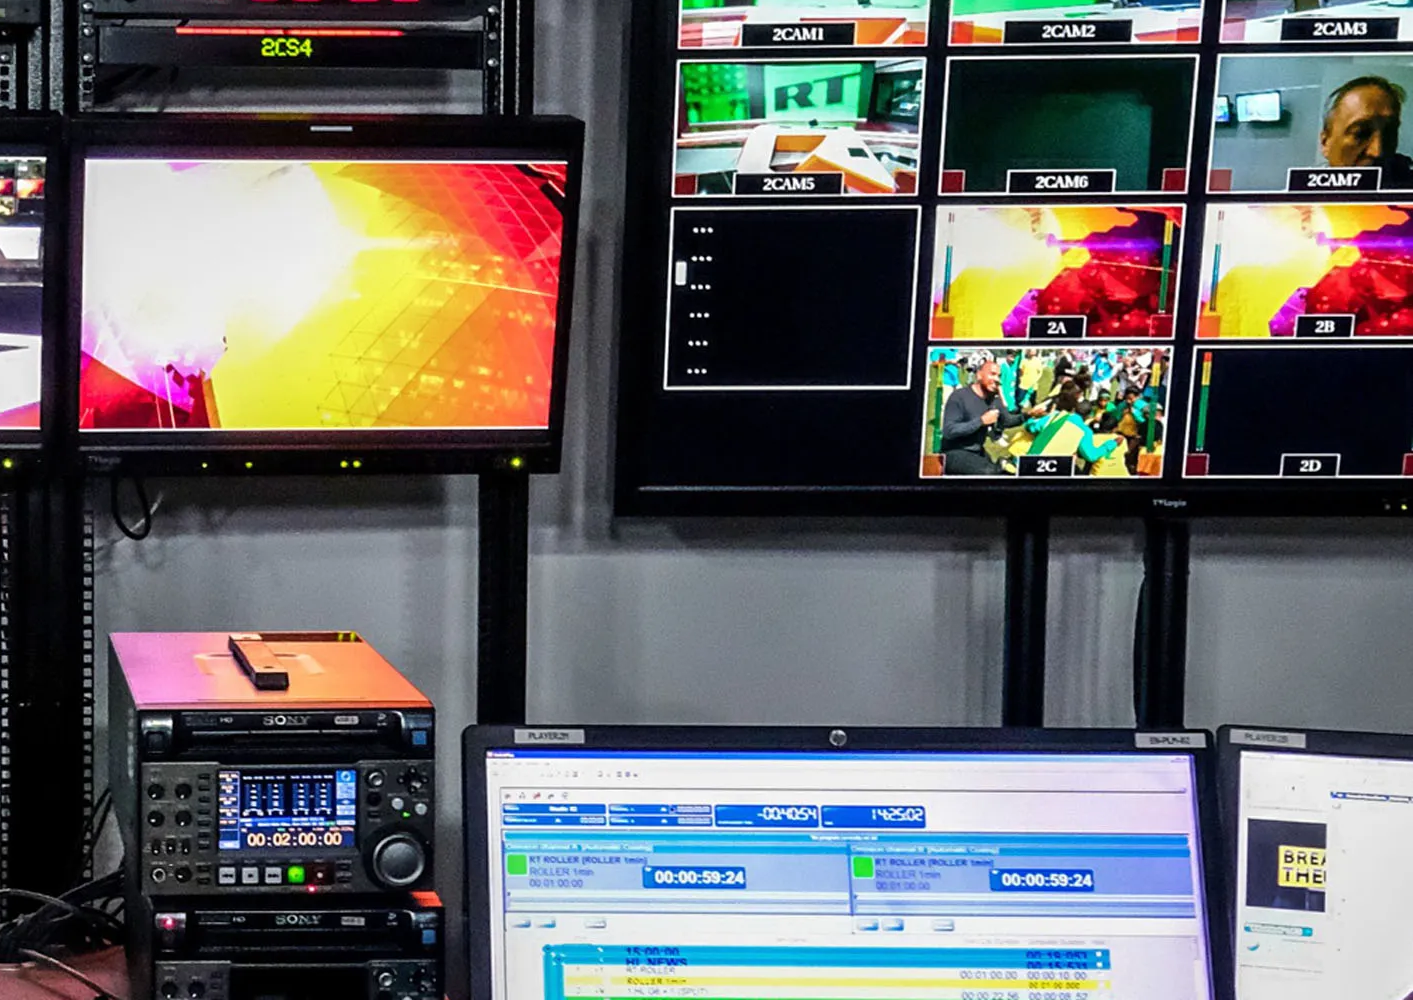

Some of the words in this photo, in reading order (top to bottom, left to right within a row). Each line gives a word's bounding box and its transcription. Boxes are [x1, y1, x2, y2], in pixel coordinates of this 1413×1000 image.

[772, 27, 824, 42] 2CAM1
[1041, 24, 1096, 39] 2CAM2
[1313, 21, 1368, 37] 2CAM3
[261, 38, 312, 57] 2CS4
[774, 72, 862, 112] RT
[762, 177, 815, 191] 2CAM5
[1034, 175, 1089, 189] 2CAM6
[1307, 172, 1362, 187] 2CAM7
[1047, 321, 1067, 334] 2A
[1314, 320, 1335, 334] 2B
[1036, 459, 1057, 473] 2C
[1299, 459, 1322, 473] 2D
[263, 714, 310, 727] SONY
[247, 832, 343, 847] 00:02:00:00
[543, 856, 579, 865] ROLLER
[890, 858, 926, 867] ROLLER
[653, 870, 745, 885] 00:00:59:24
[1001, 872, 1093, 887] 00:00:59:24
[1282, 867, 1326, 884] THE
[275, 914, 322, 926] SONY
